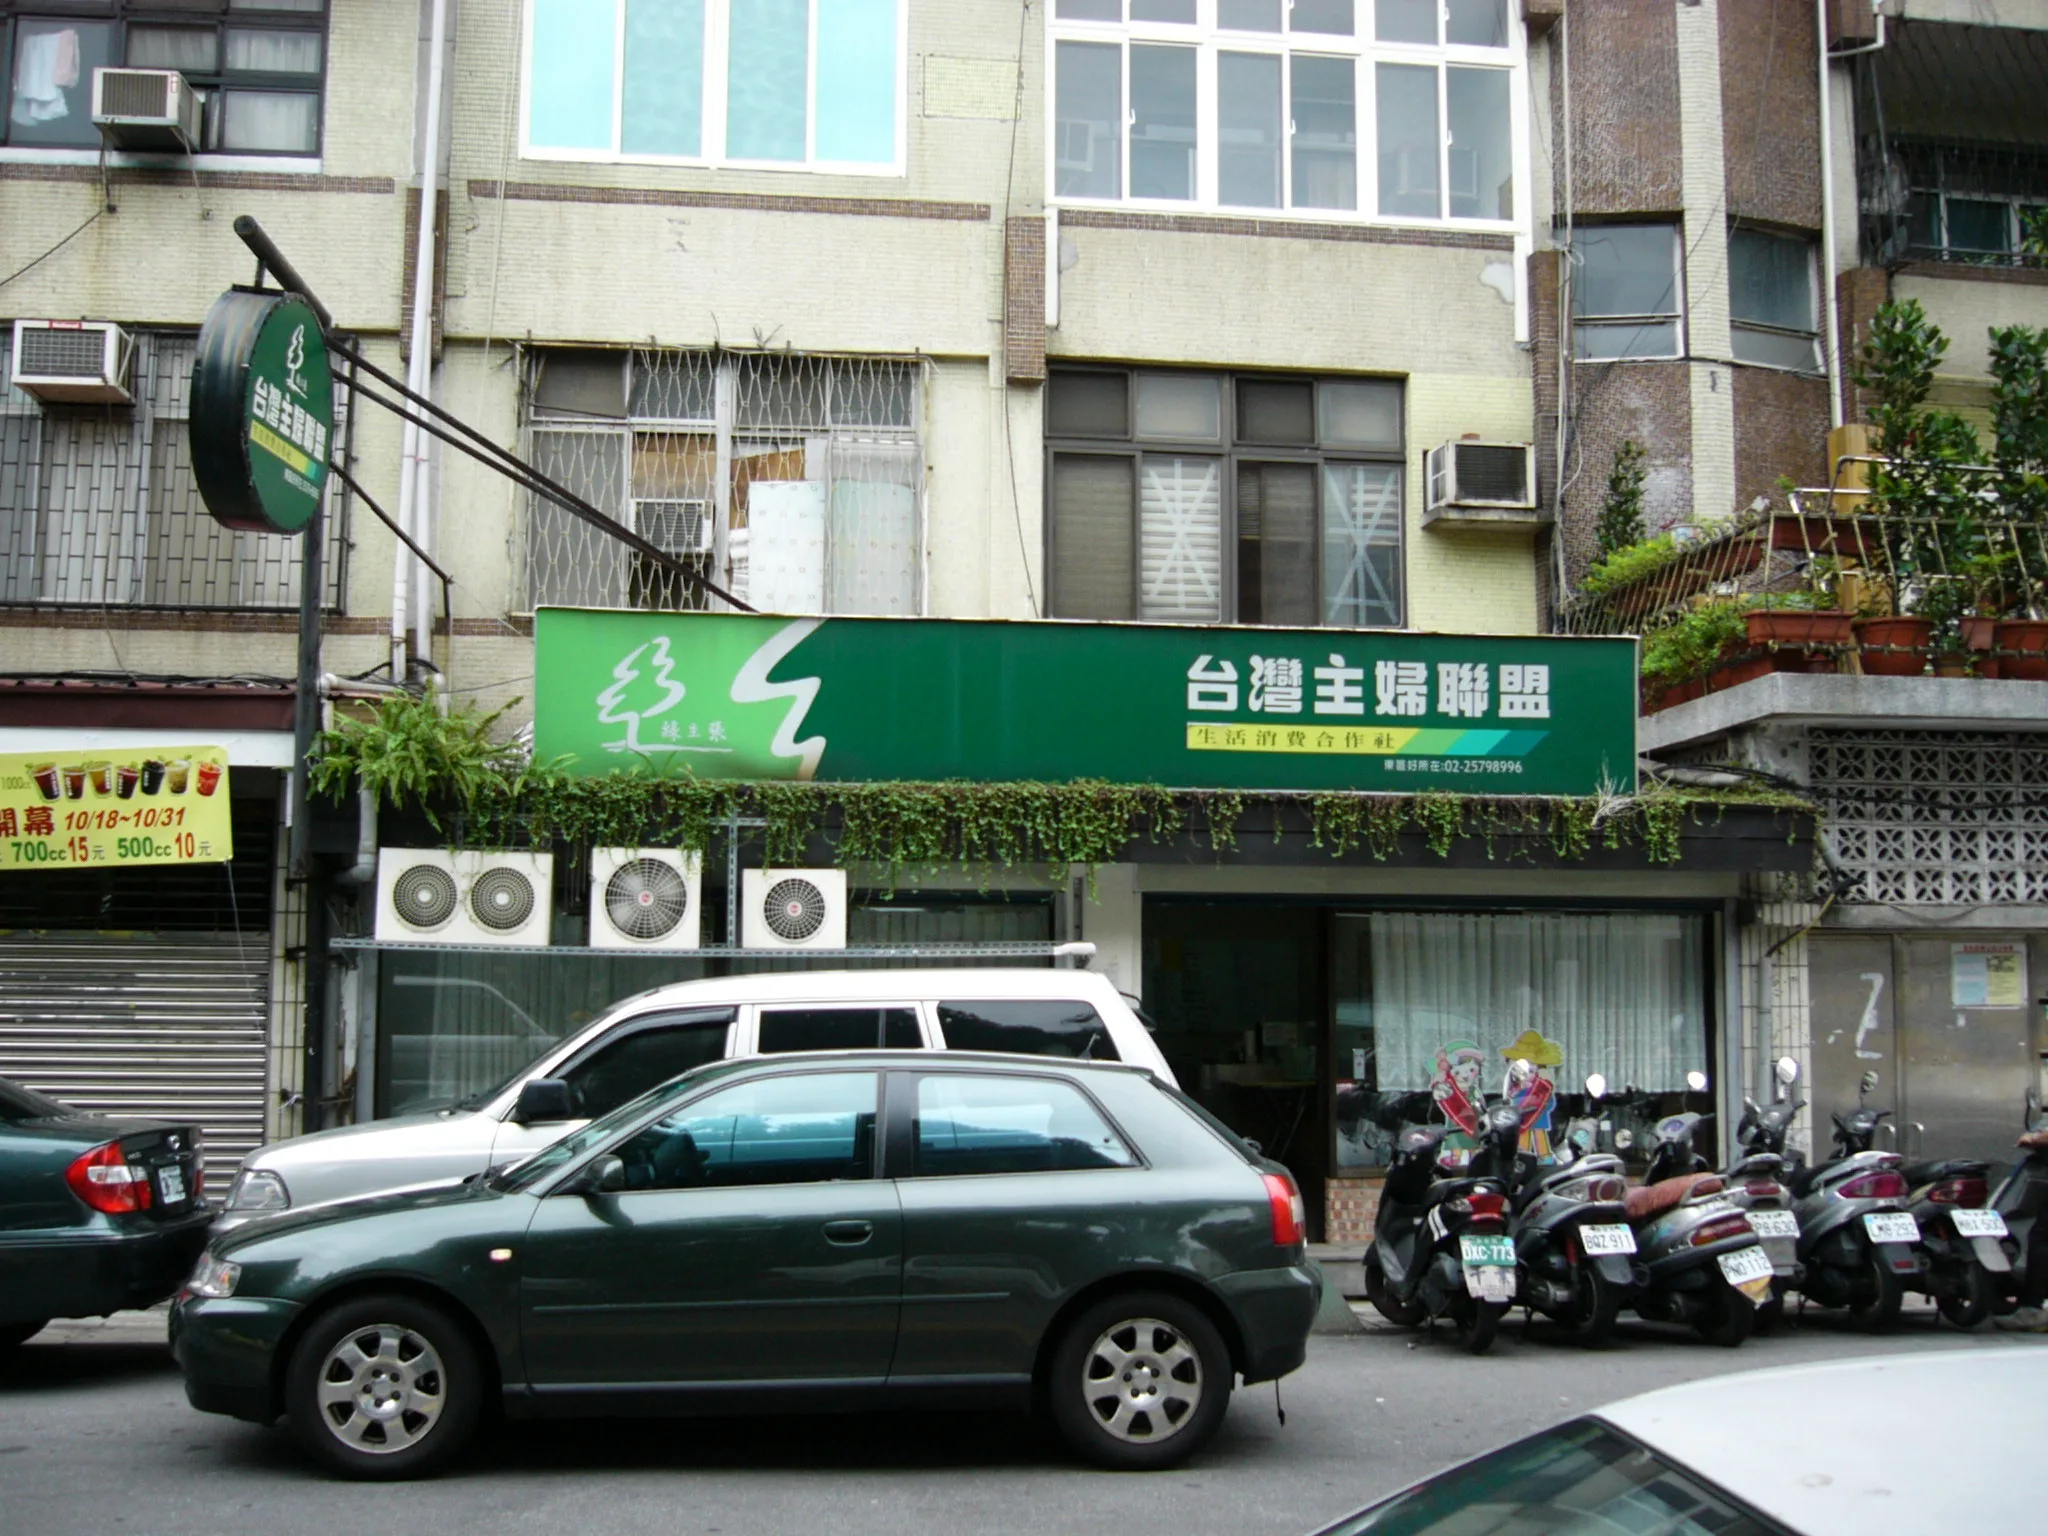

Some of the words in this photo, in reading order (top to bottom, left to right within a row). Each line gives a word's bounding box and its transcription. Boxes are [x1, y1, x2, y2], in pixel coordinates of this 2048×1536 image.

[1186, 652, 1551, 719] 台灣主婦聯盟
[1195, 727, 1395, 750] 生活消費合作社
[64, 807, 187, 831] 10/18~10/31
